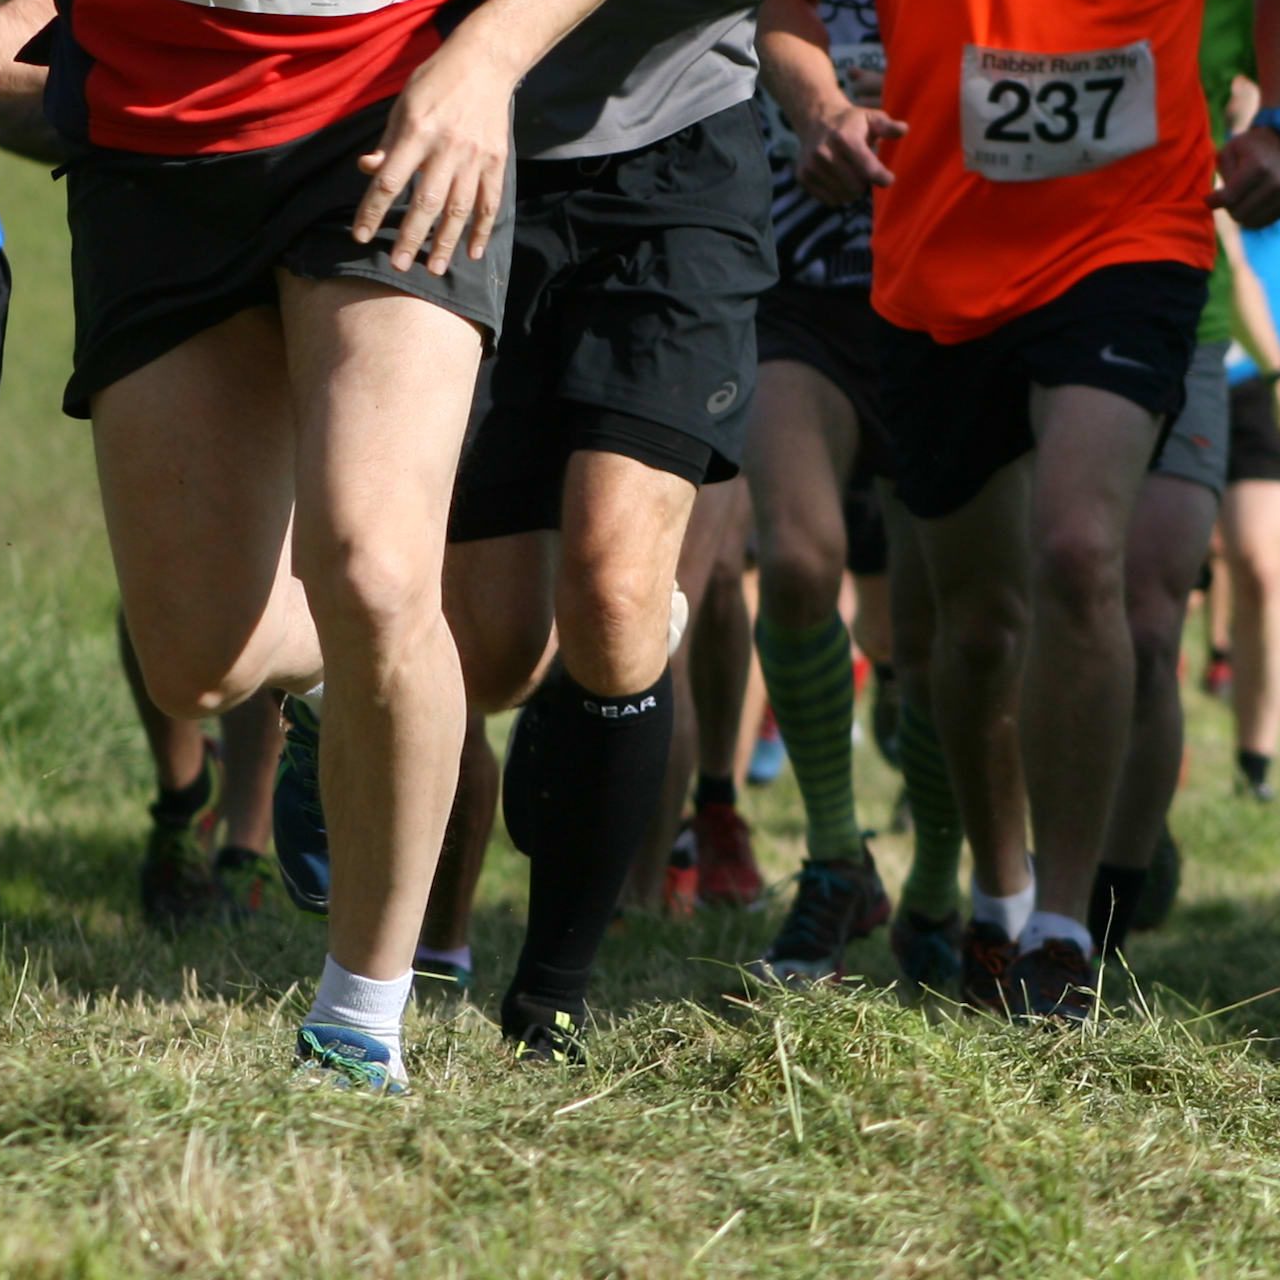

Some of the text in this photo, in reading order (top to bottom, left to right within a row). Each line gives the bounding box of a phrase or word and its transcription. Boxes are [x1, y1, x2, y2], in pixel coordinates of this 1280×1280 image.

[982, 53, 1046, 73] Rabbit
[1050, 58, 1091, 73] Run
[984, 77, 1125, 144] 237
